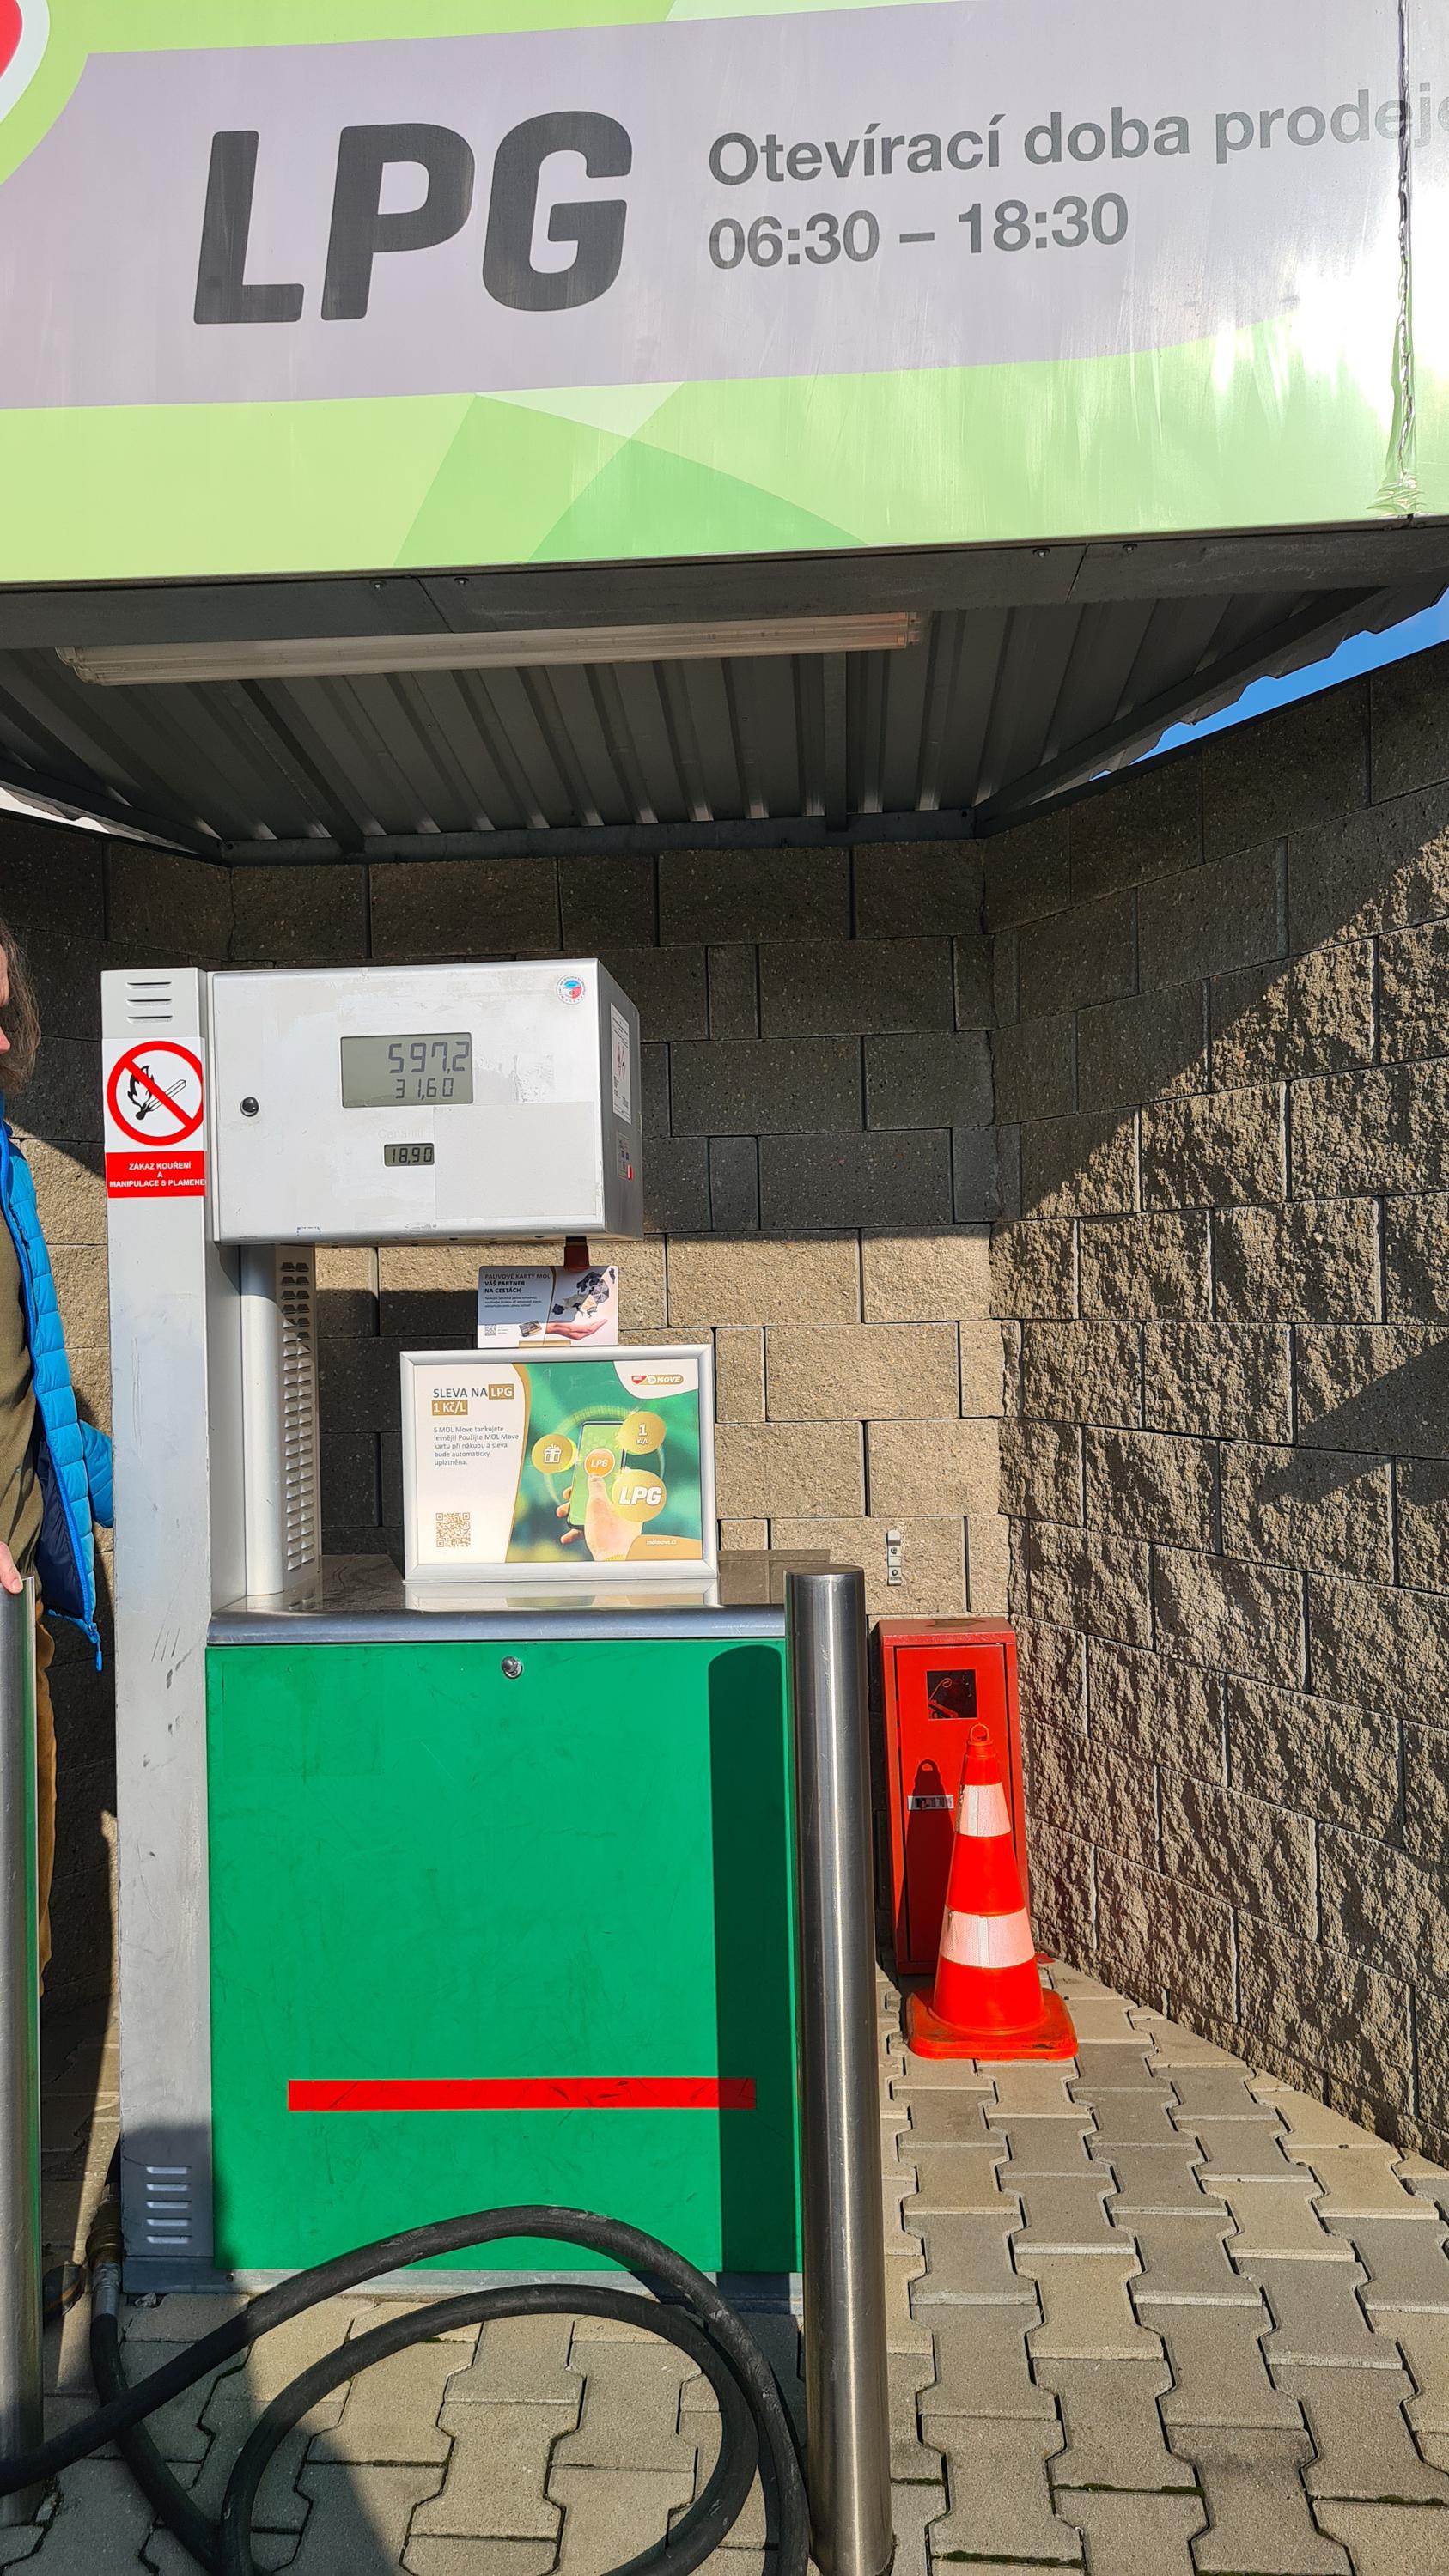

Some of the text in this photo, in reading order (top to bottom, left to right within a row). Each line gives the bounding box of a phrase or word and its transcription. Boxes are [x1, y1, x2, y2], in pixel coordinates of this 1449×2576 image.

[709, 113, 1007, 185] Otevírací
[1024, 107, 1190, 165] doba
[193, 111, 633, 325] LPG
[709, 211, 880, 270] 06:30
[958, 192, 1129, 254] 18:30
[388, 1041, 470, 1073] 597,2
[395, 1078, 454, 1100] 31,60
[392, 1147, 433, 1165] 18,90
[129, 1161, 191, 1170] ZÁKAZ KOUŘENÍ
[109, 1179, 159, 1188] MANIPULACE
[433, 1387, 513, 1398] SLEVA NA LPG
[433, 1401, 466, 1414] 1 Kč/L
[638, 1424, 647, 1436] 1
[619, 1486, 662, 1505] LPG
